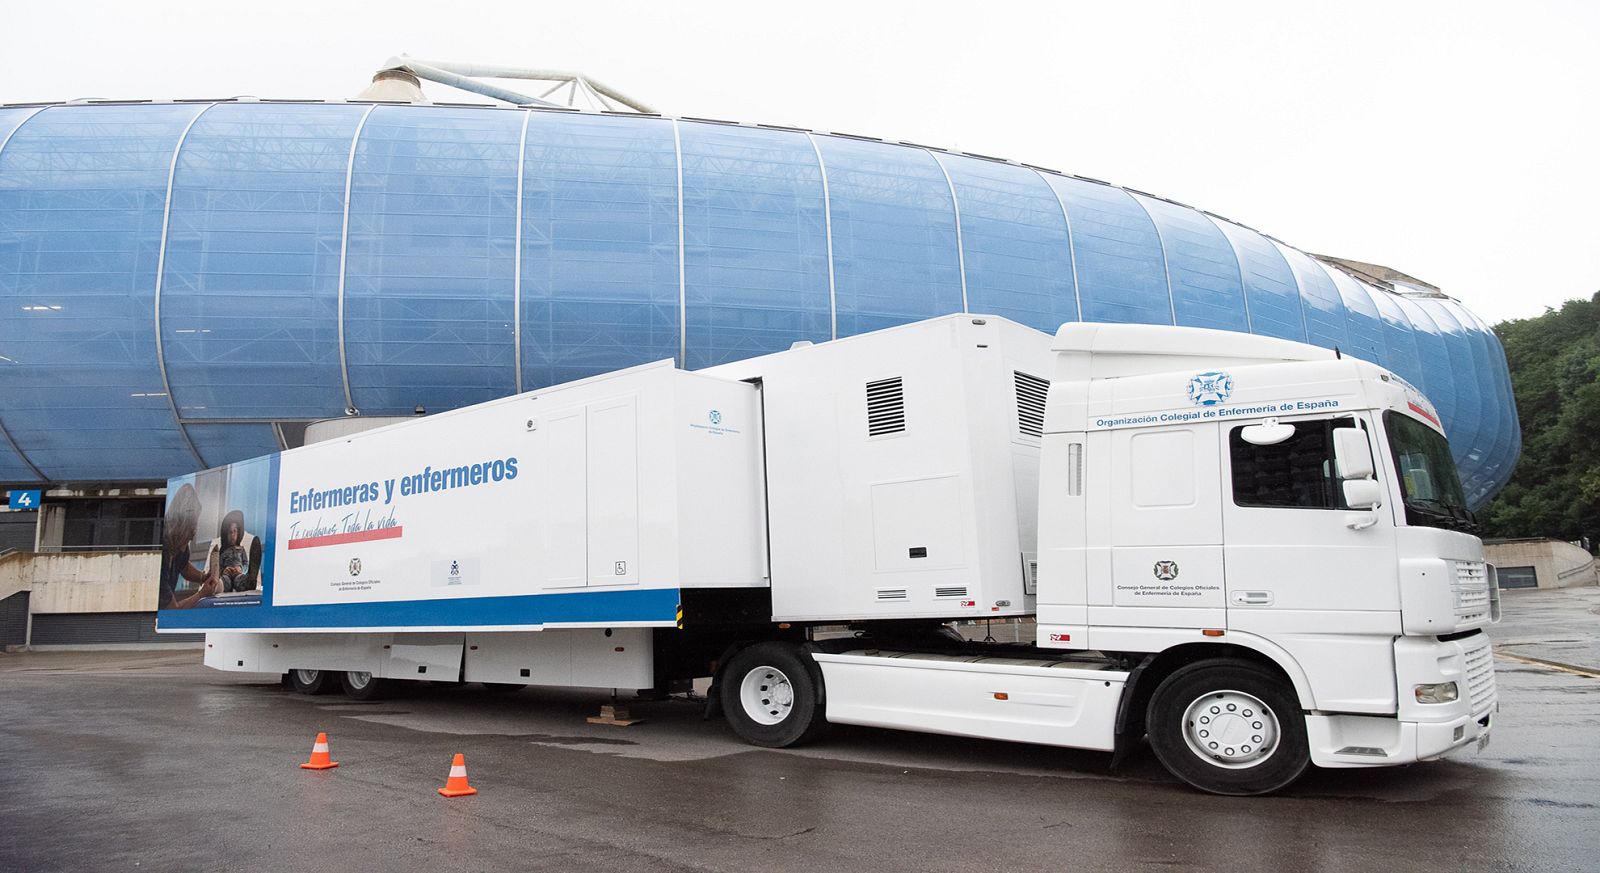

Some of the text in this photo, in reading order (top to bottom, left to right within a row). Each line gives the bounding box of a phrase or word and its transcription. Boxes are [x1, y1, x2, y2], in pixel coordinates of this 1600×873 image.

[1096, 400, 1339, 427] Organización Colegial de Enfermería de España
[290, 457, 519, 514] Enfermeras y enfermeros
[18, 492, 32, 506] 4
[377, 505, 398, 530] vida
